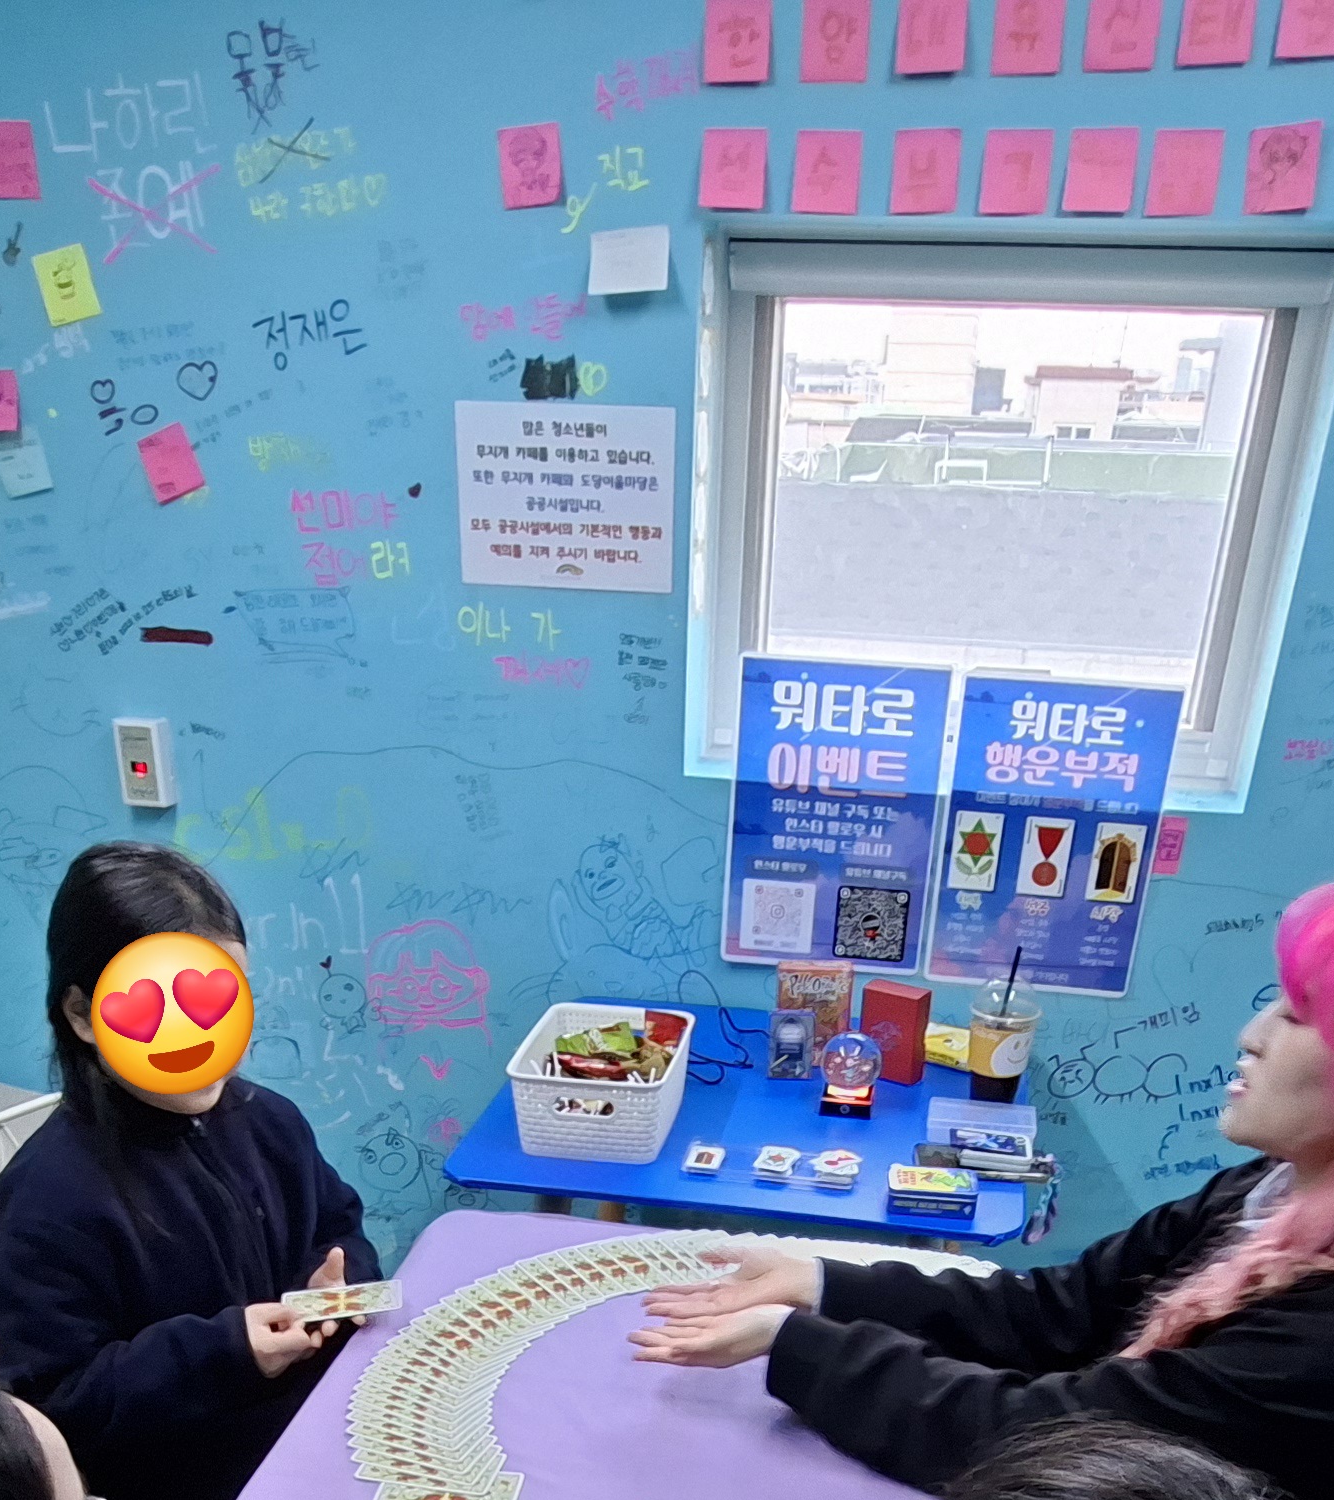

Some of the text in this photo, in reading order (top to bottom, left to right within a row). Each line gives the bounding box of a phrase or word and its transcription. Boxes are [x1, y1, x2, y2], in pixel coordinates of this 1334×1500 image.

[251, 298, 369, 372] 정재은
[476, 444, 509, 460] 무지개
[555, 448, 600, 463] 이용하고
[472, 470, 494, 485] 또한
[501, 470, 534, 485] 무지개
[470, 518, 491, 533] 모두
[556, 546, 588, 561] 주시기
[767, 742, 908, 799] 이벤트
[985, 742, 1139, 793] 행운부적
